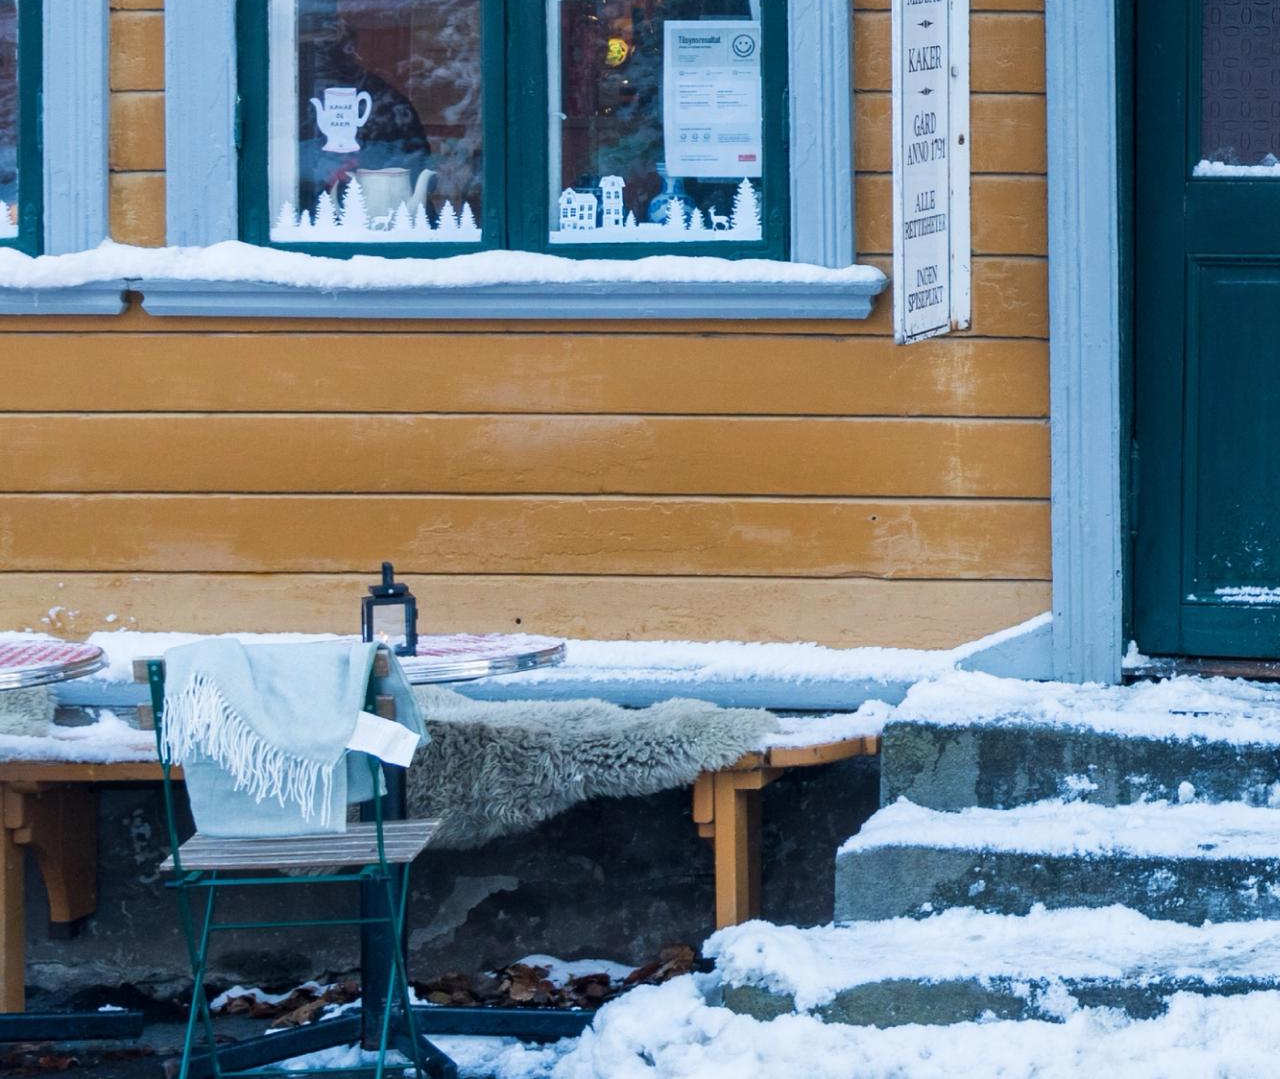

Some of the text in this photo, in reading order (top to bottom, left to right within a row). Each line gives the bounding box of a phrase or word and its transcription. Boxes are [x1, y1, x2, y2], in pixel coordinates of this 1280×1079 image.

[908, 45, 942, 73] KAKER
[914, 110, 937, 137] GÅRD
[907, 137, 946, 166] ANNO 1791
[914, 190, 936, 212] ALLE
[917, 265, 938, 287] INGEN
[908, 286, 943, 312] SPISEPLIKT
